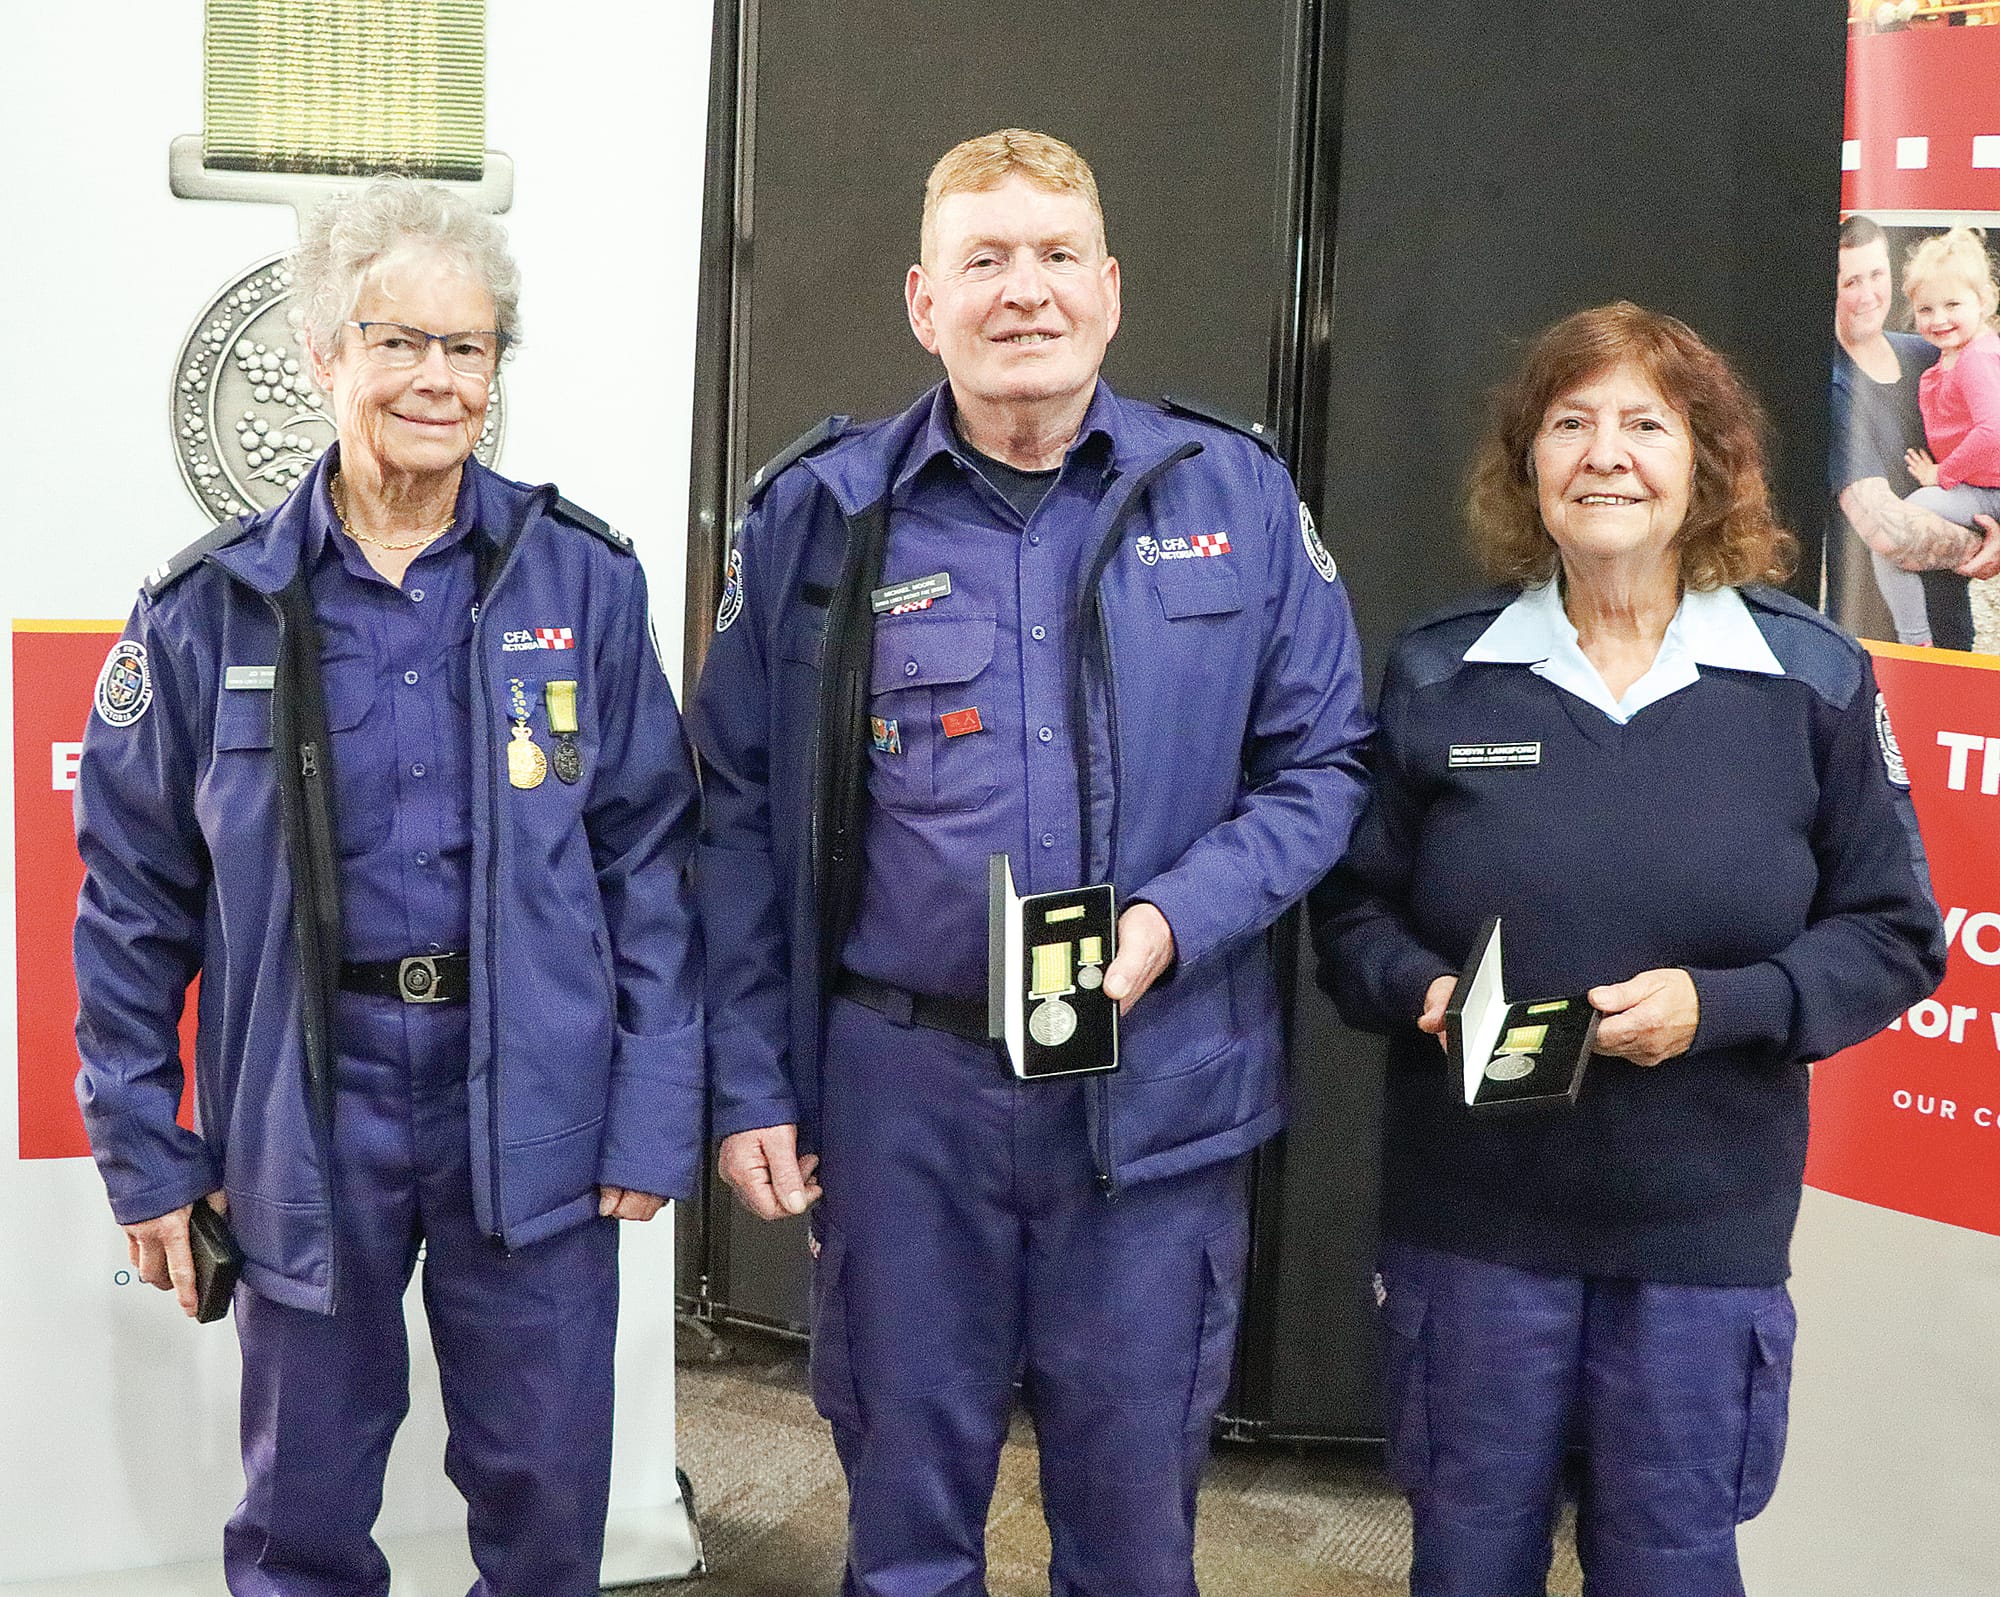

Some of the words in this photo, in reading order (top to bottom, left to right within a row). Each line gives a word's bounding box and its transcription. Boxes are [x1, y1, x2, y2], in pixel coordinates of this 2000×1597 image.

[1162, 538, 1188, 551] CFA
[503, 630, 533, 643] CFA
[1887, 998, 1978, 1043] or
[1893, 1089, 1957, 1120] OUR
